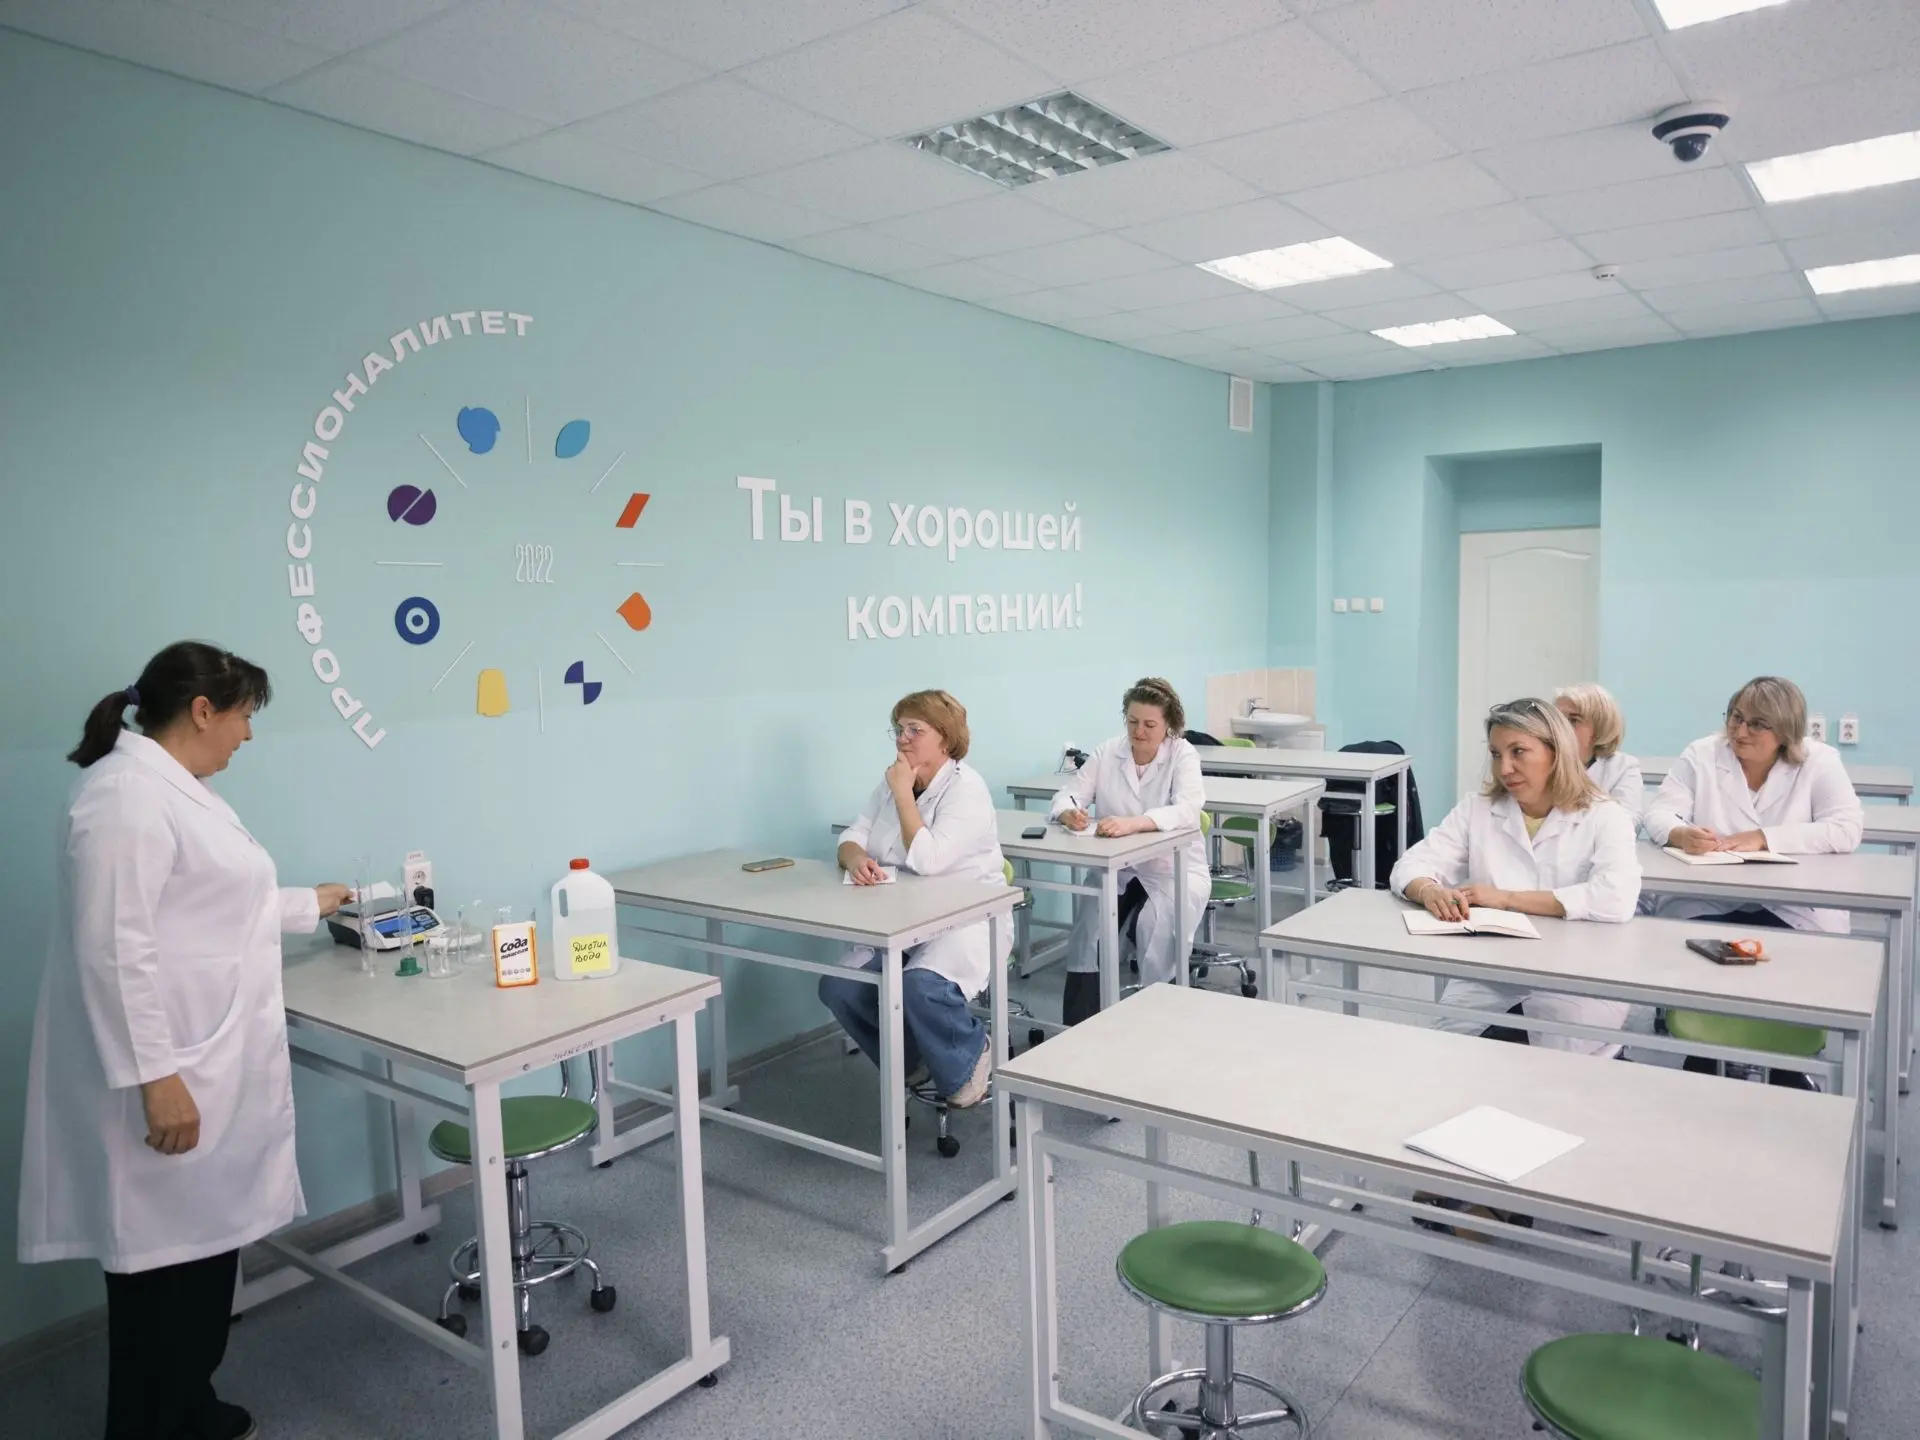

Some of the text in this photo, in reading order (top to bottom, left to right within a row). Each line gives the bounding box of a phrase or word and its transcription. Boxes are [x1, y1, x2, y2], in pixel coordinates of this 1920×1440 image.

[286, 310, 534, 750] ПРОФЕССИОНАЛИТЕТ
[736, 476, 1081, 561] Ты в хорошей
[514, 543, 555, 584] 2022
[846, 582, 1084, 640] компании!
[500, 938, 528, 953] Сода
